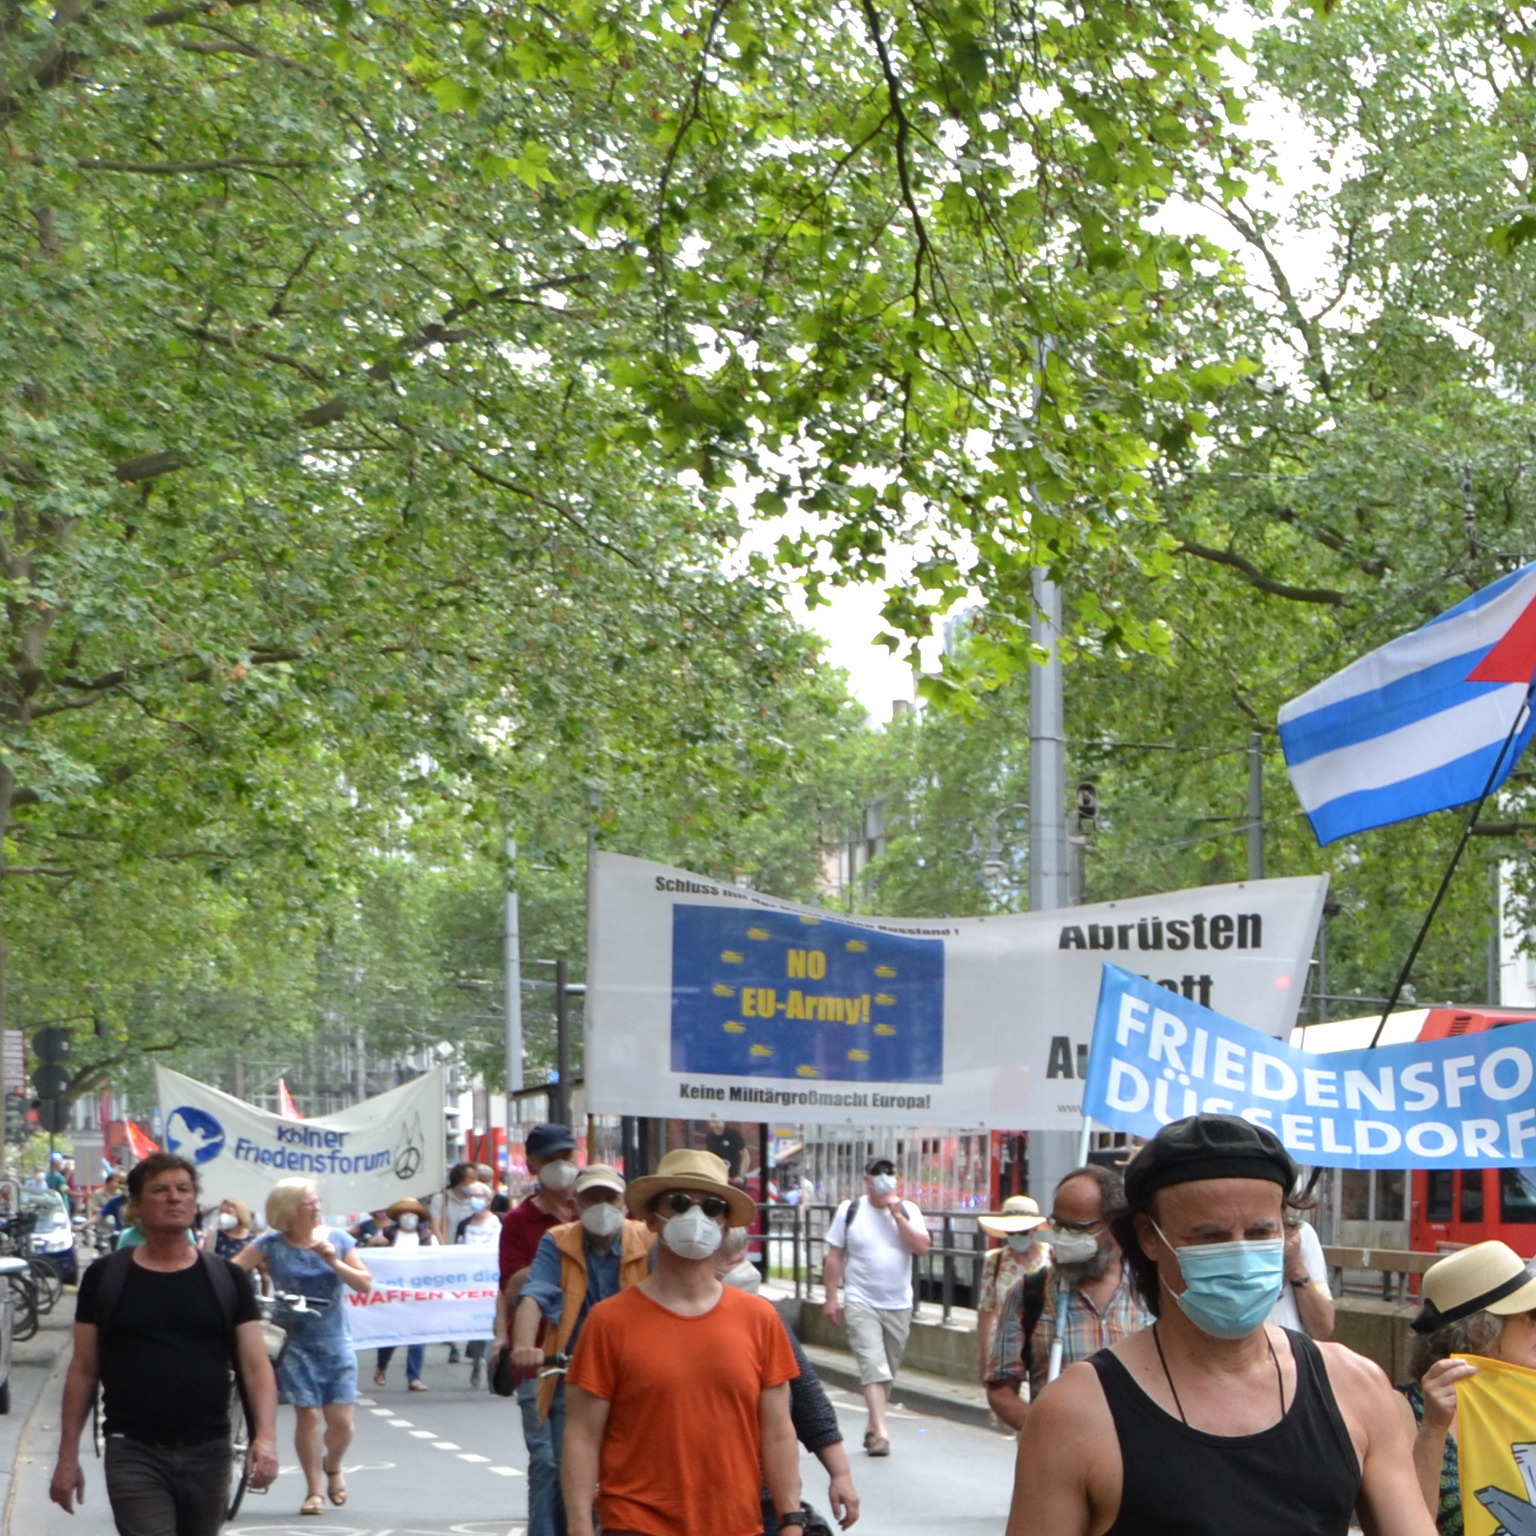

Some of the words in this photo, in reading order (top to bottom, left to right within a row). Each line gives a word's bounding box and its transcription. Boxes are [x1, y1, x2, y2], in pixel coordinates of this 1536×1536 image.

[655, 876, 720, 897] Schluss
[1058, 913, 1263, 951] Abrüsten
[787, 948, 827, 980] NO
[742, 987, 871, 1026] EU-Army!
[680, 1083, 726, 1101] Keine
[729, 1086, 868, 1107] Militärgroßmacht
[872, 1092, 931, 1109] Europa!
[277, 1125, 349, 1149] Kölner
[235, 1137, 391, 1175] Friedensforum
[410, 1271, 468, 1288] gegen
[345, 1288, 443, 1306] WAFFEN
